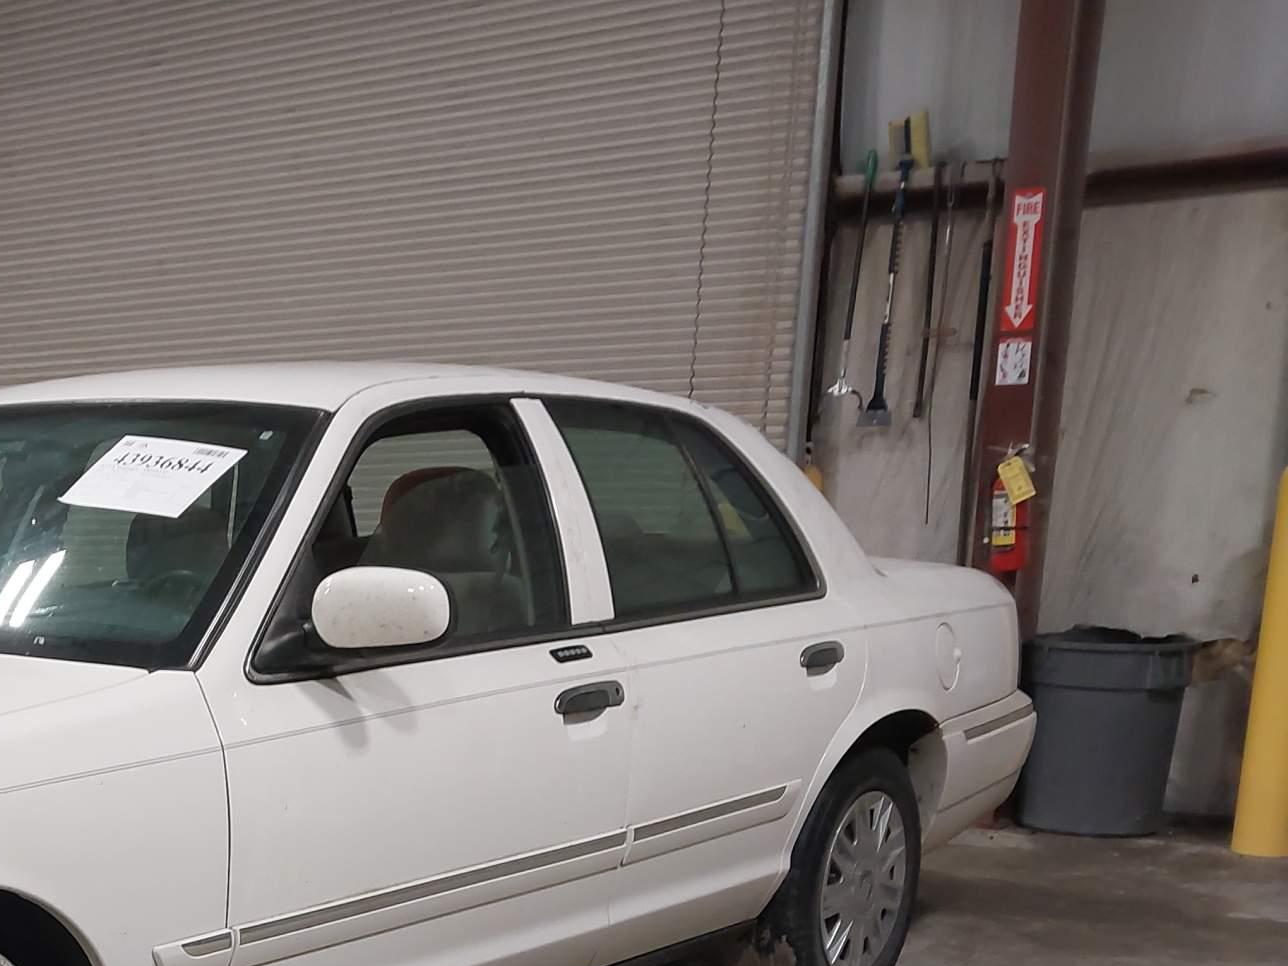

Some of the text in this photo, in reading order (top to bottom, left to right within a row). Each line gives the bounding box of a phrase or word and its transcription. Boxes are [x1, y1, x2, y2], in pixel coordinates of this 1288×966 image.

[1016, 201, 1041, 216] FIRE
[1013, 221, 1029, 319] EXTINGUISHER
[113, 452, 214, 474] 43936844
